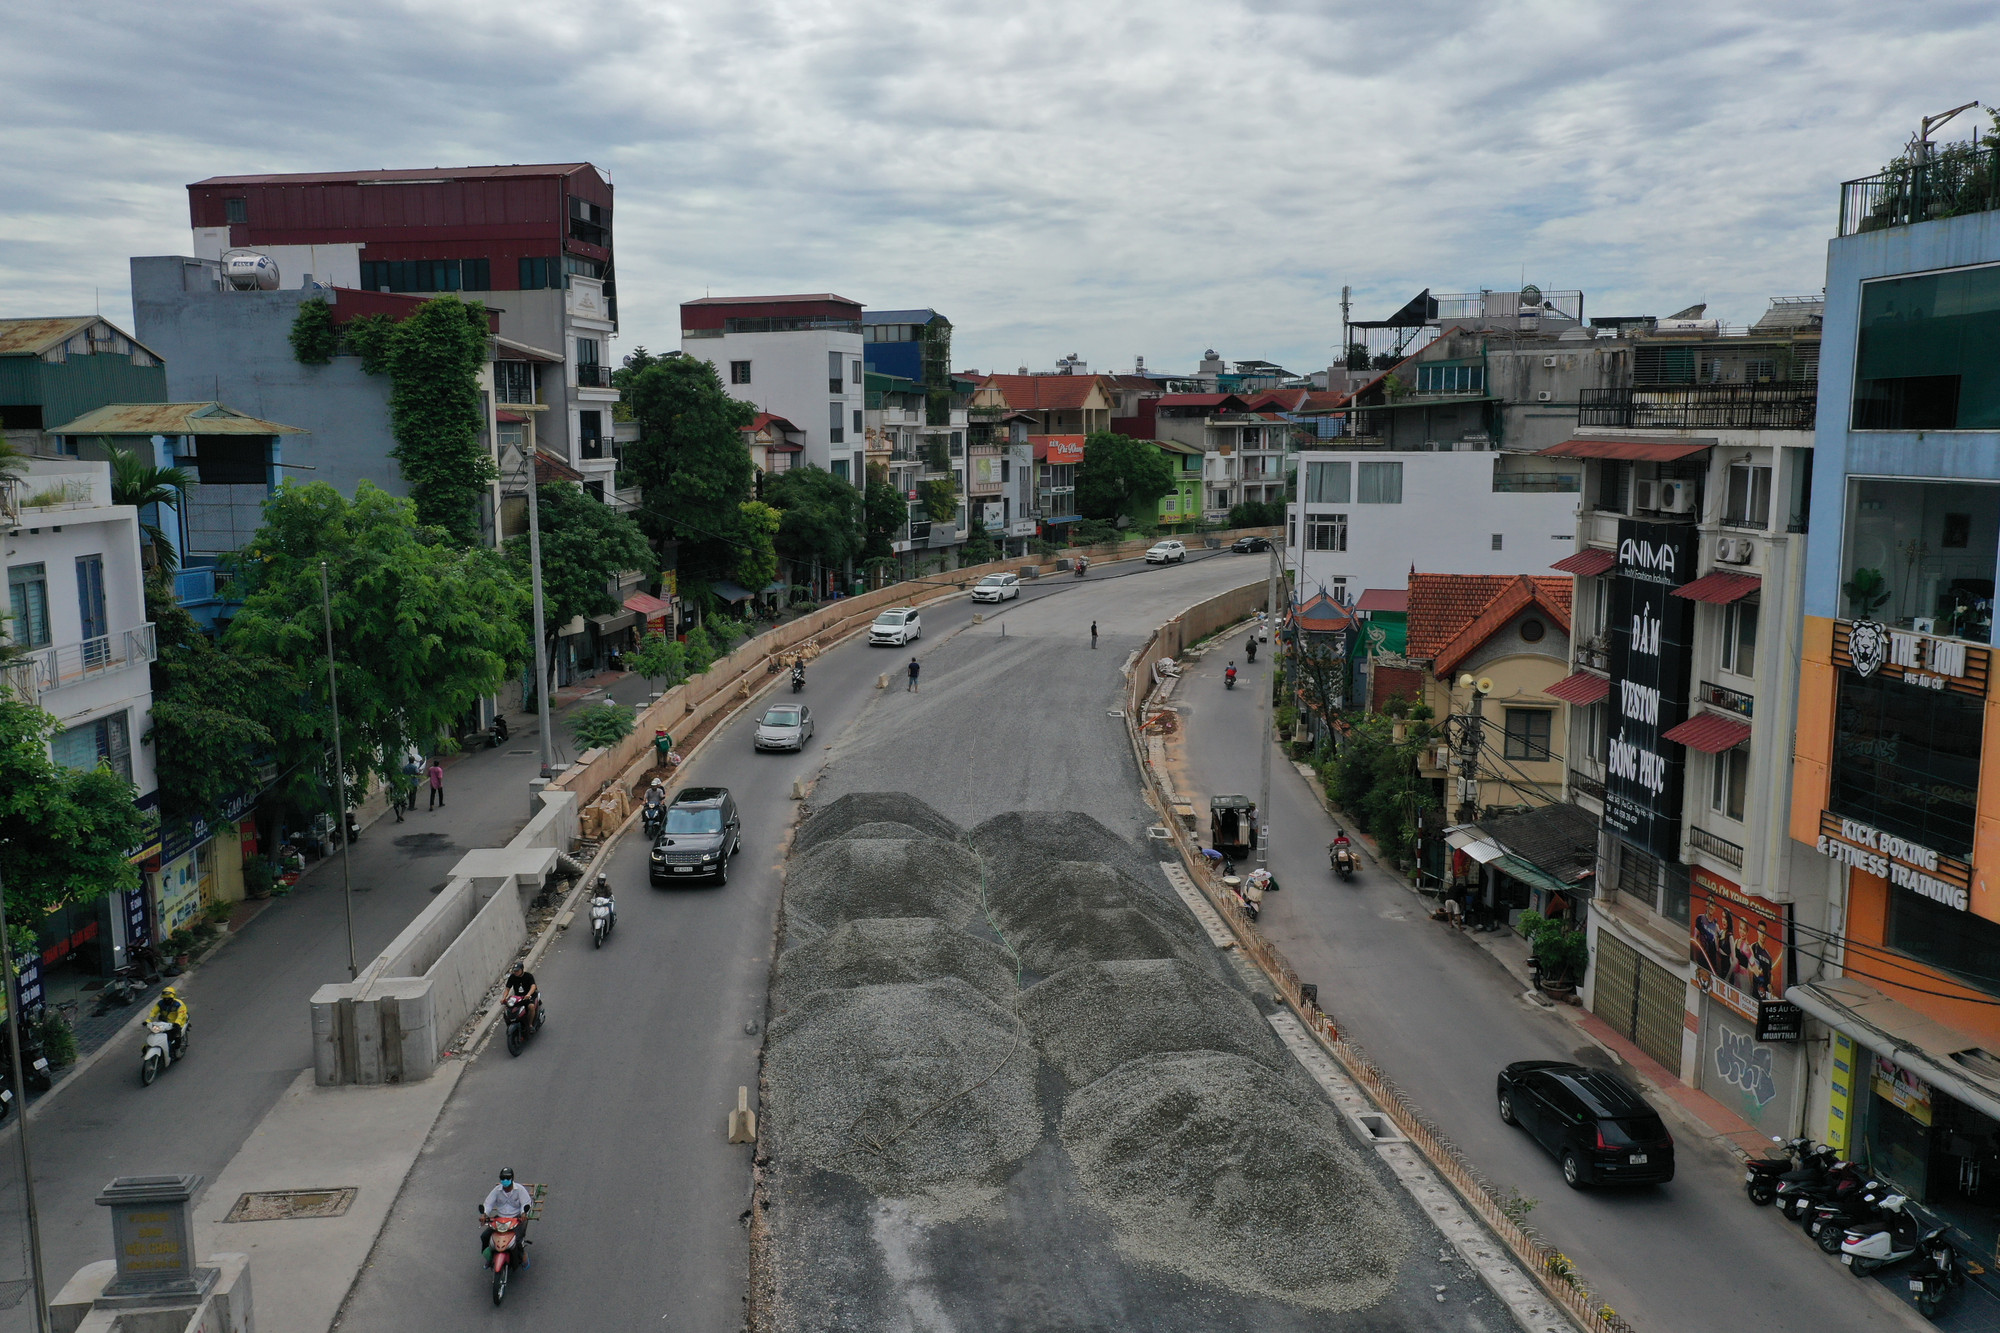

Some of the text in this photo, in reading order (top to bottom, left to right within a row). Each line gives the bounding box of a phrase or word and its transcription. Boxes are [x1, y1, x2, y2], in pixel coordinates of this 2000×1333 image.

[1619, 538, 1675, 573] ANIMA
[1632, 601, 1660, 656] ĐẦM
[1890, 632, 1966, 678] THE LION
[1621, 679, 1660, 726] VESTON
[1609, 726, 1665, 798] ĐỒNG PHỤC
[1841, 818, 1938, 872] KICK BOXING
[1730, 889, 1750, 906] YOUR
[1816, 835, 1969, 912] & FITNESS TRAINING
